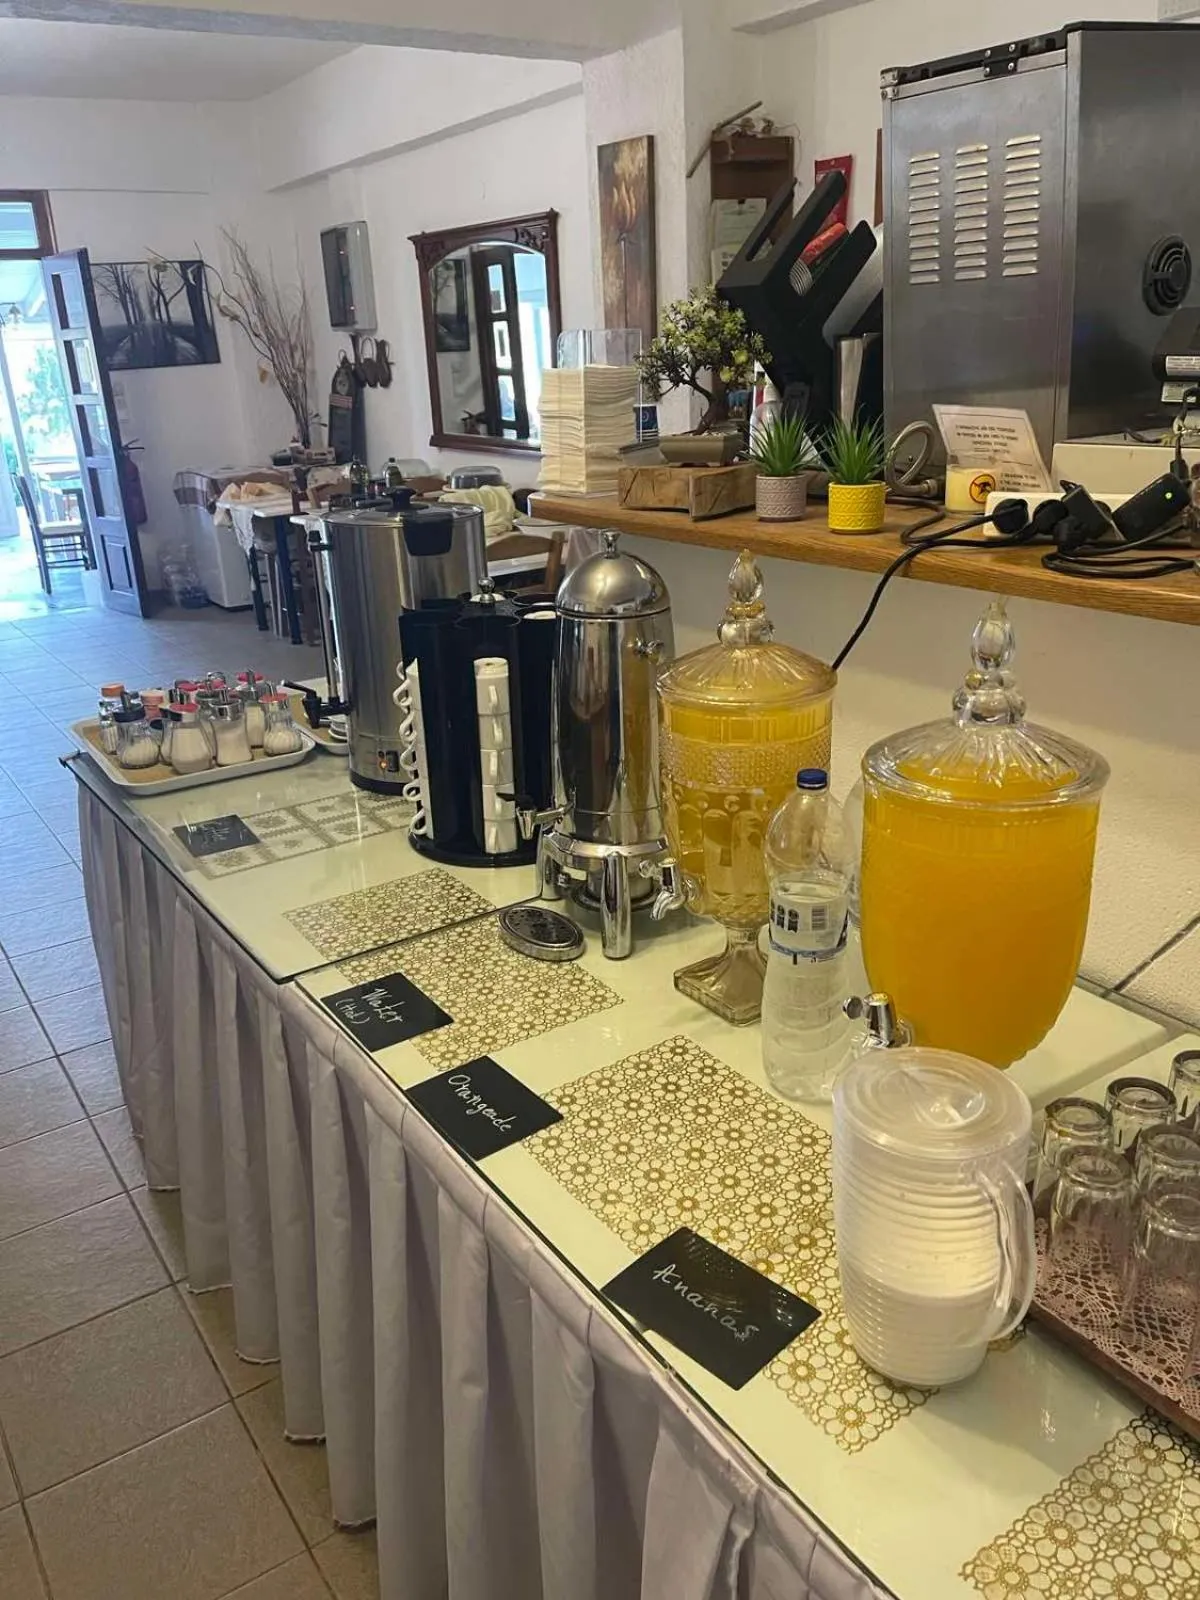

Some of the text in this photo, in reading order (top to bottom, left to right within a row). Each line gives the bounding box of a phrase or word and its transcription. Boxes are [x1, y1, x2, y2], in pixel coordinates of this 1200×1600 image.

[361, 988, 403, 1023] Water
[448, 1075, 515, 1132] Orangeade
[652, 1263, 760, 1341] Ananas
